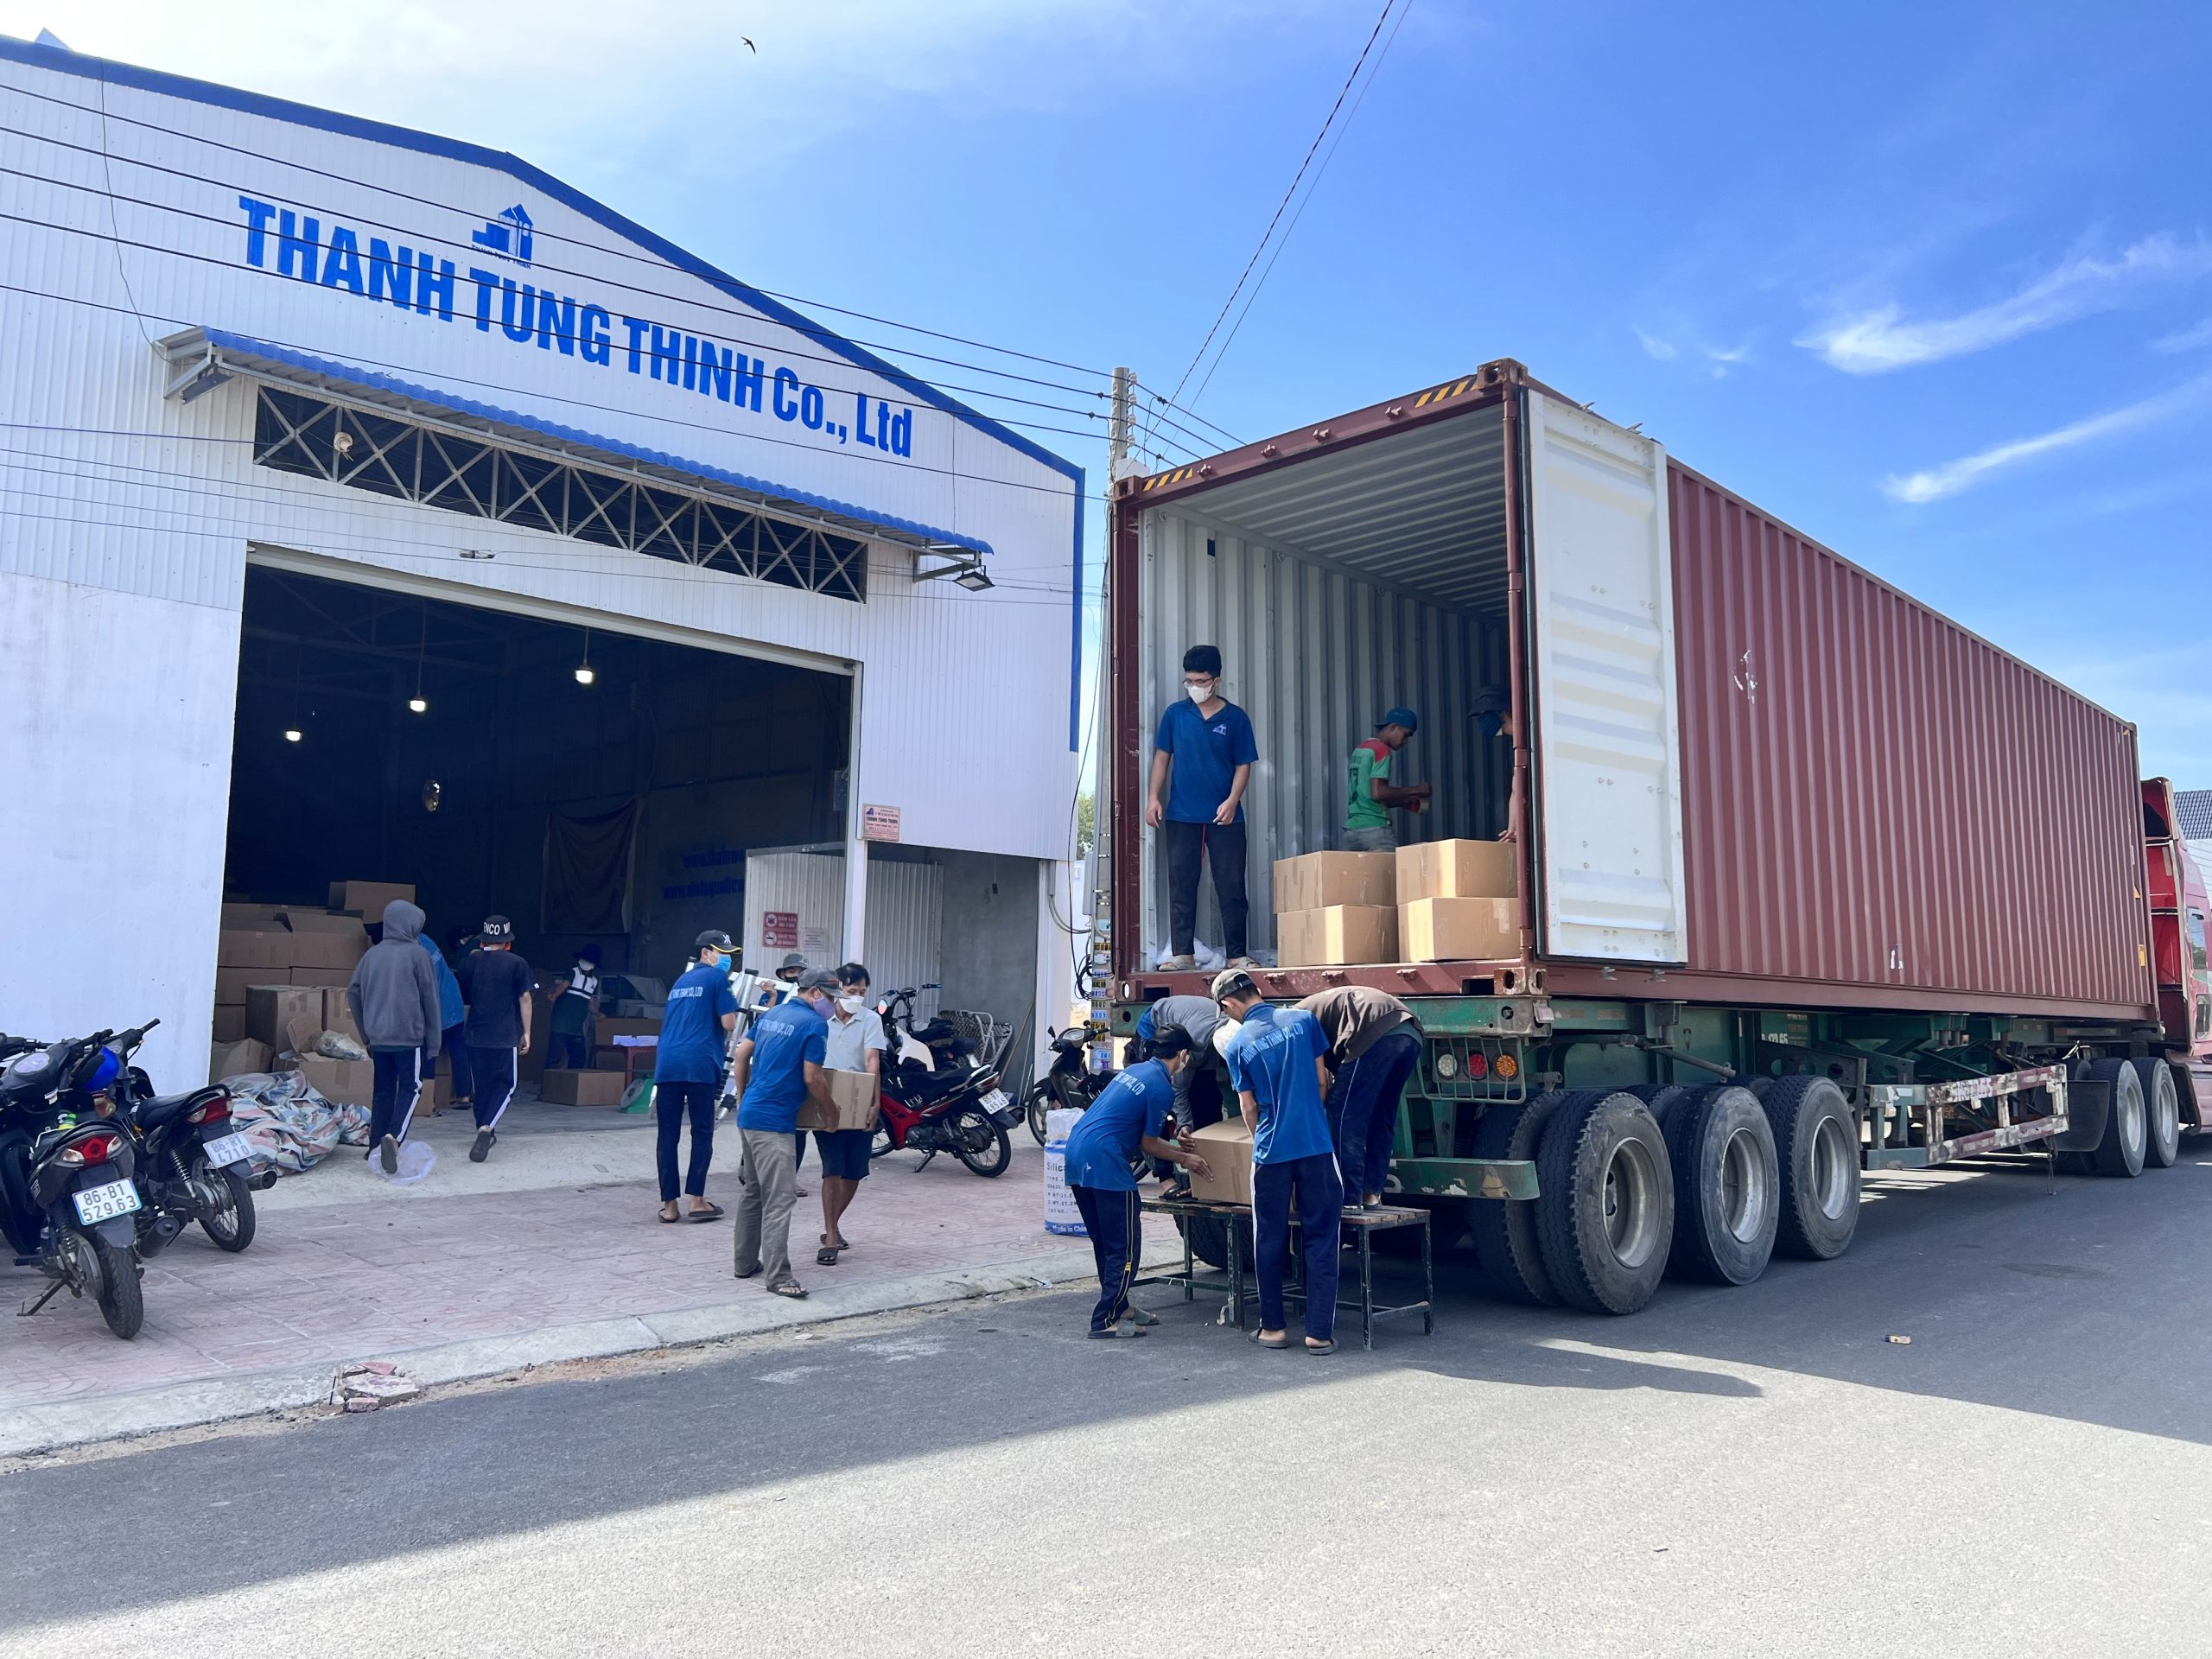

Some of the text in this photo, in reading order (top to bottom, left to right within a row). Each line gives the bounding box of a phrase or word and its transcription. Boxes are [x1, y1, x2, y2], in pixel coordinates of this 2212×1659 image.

[238, 194, 912, 459] THANH TUNG THINH Co., Ltd
[1292, 1022, 1304, 1035] LTD
[1131, 1081, 1146, 1096] LTD
[211, 1134, 243, 1153] 86-R1
[217, 1144, 250, 1163] 4710
[83, 1183, 125, 1205] 86-B1
[81, 1195, 137, 1222] 529.63
[1073, 1224, 1087, 1233] Chin
